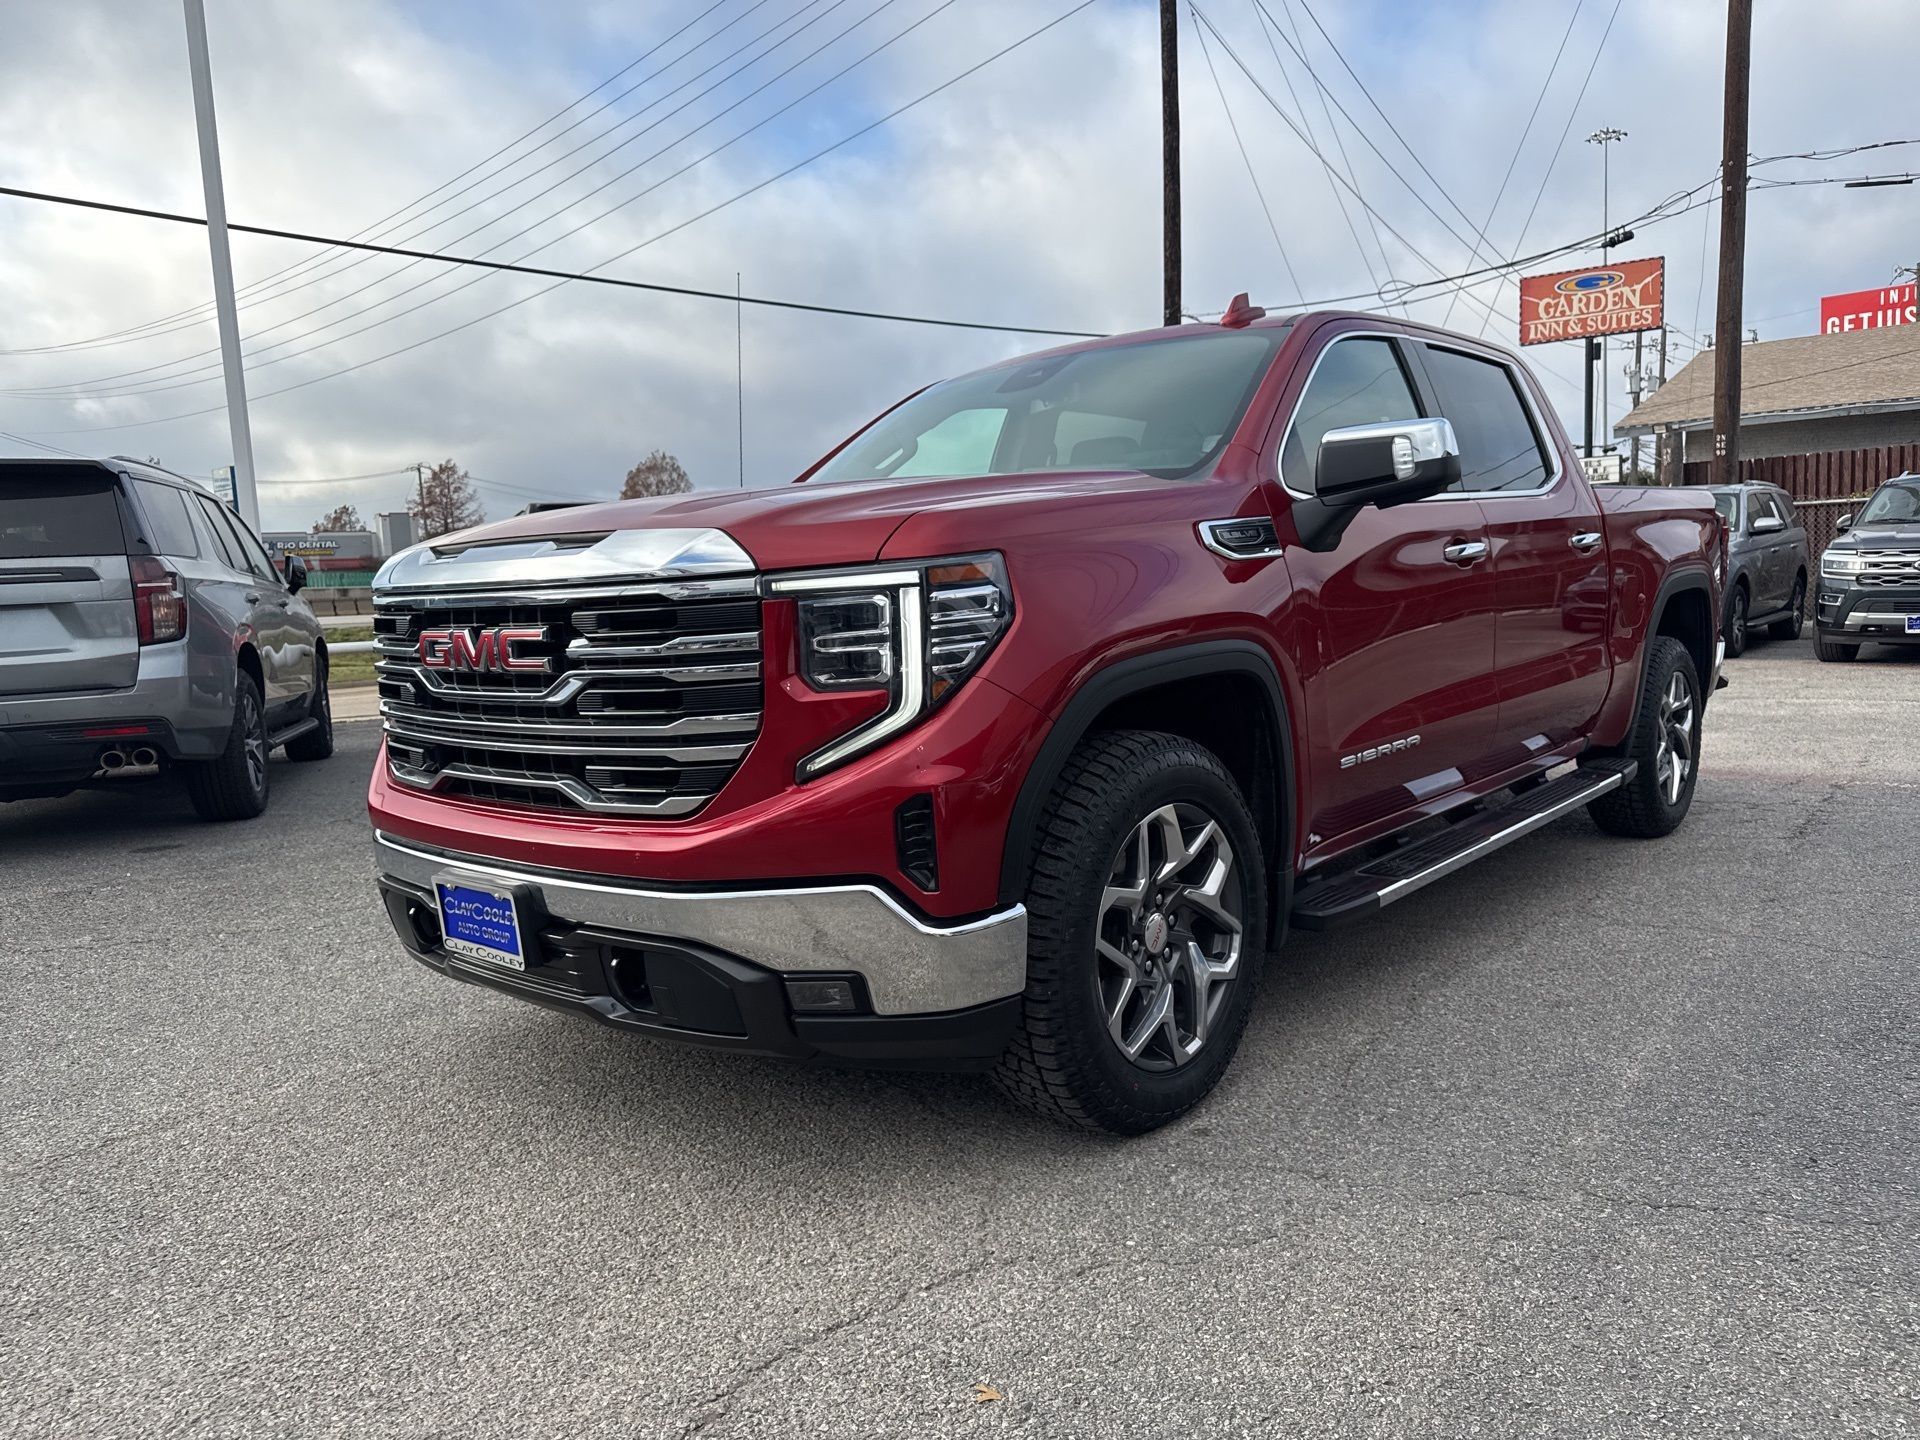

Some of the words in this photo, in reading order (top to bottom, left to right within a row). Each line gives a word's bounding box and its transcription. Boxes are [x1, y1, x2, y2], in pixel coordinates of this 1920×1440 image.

[1538, 284, 1641, 319] GARDEN
[1529, 321, 1565, 340] INN
[1567, 319, 1584, 334] &
[1586, 308, 1653, 332] SUITES
[298, 540, 338, 548] DENTAL
[419, 628, 552, 672] GMC
[1340, 734, 1421, 769] SIERRA
[458, 921, 480, 937] AUTO
[482, 926, 511, 944] GROUP
[444, 938, 474, 954] CLAY
[475, 947, 524, 968] COOLEY
